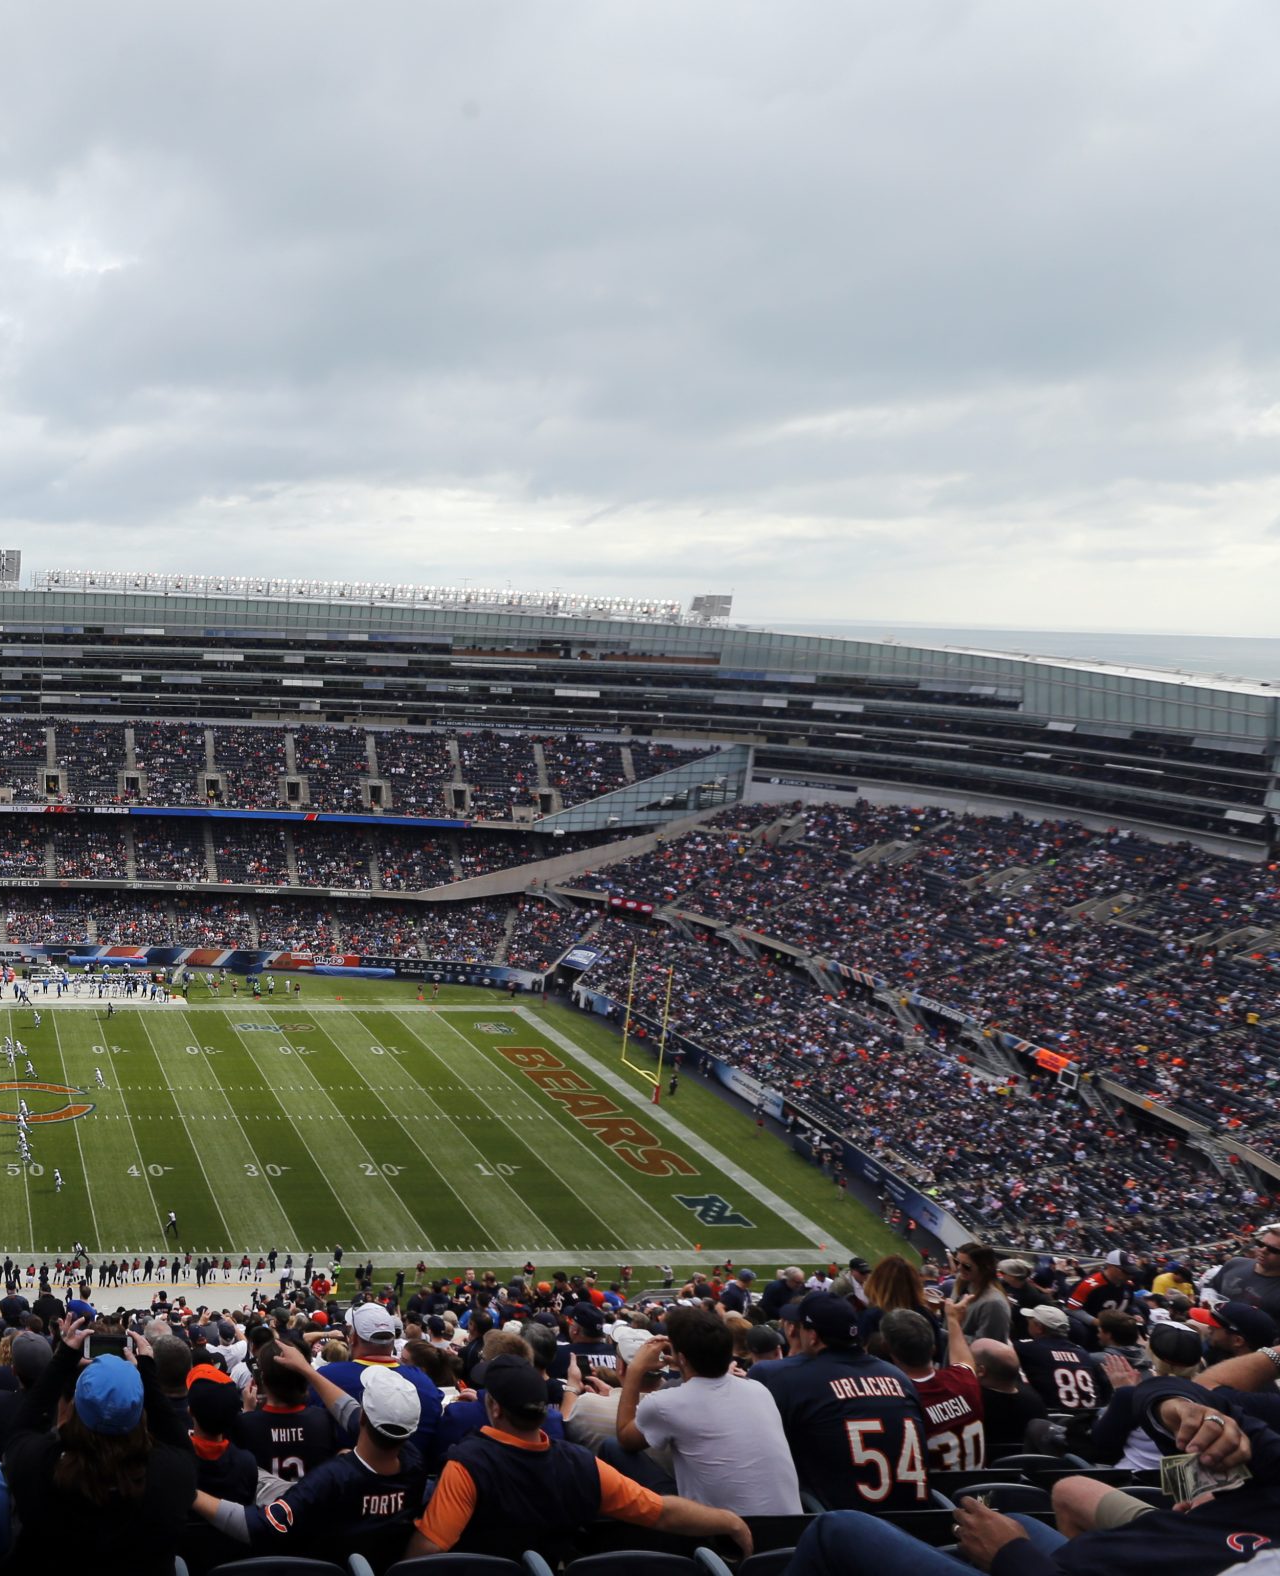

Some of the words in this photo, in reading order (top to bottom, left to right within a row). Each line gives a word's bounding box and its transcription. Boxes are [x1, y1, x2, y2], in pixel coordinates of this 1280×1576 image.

[279, 1046, 312, 1056] 20
[370, 1046, 402, 1055] 10
[493, 1046, 701, 1176] BEARS
[7, 1163, 44, 1176] 50
[126, 1163, 165, 1176] 40
[243, 1163, 282, 1176] 30
[358, 1163, 398, 1176] 20
[475, 1163, 515, 1176] 10
[1051, 1350, 1080, 1363] DITKA
[829, 1376, 906, 1400] URLACHER
[1053, 1367, 1097, 1408] 89
[925, 1395, 972, 1425] NICOSIA
[271, 1427, 305, 1443] WHITE
[927, 1420, 985, 1472] 30
[844, 1417, 928, 1503] 54
[362, 1492, 405, 1516] FORTE
